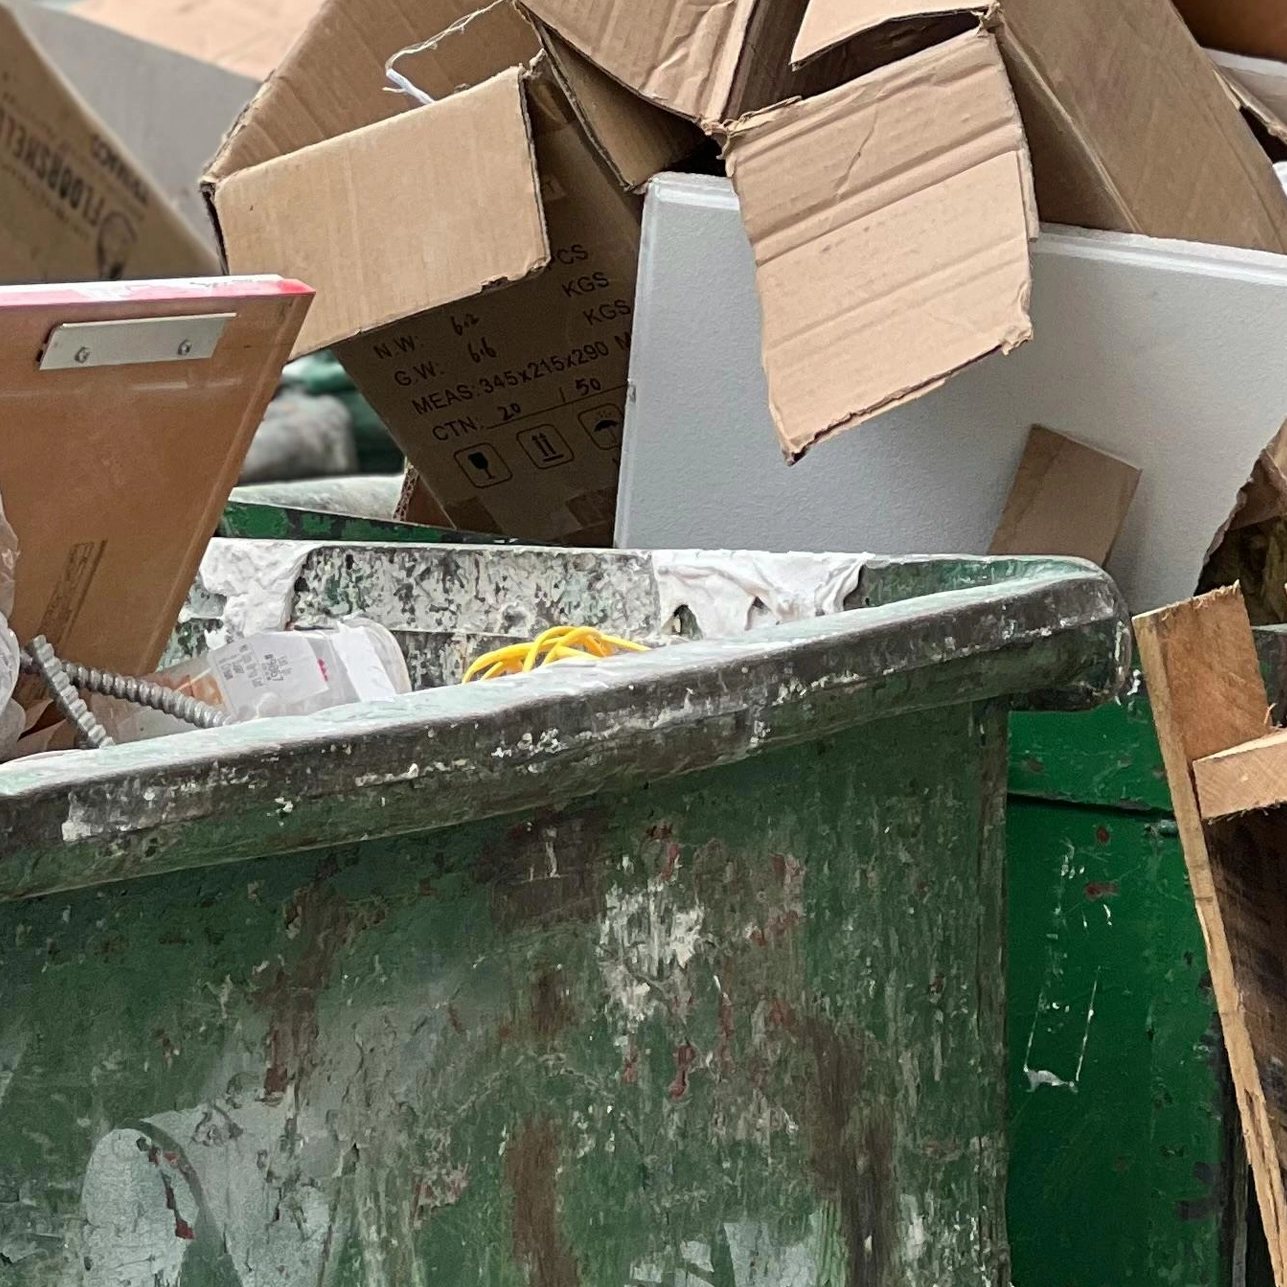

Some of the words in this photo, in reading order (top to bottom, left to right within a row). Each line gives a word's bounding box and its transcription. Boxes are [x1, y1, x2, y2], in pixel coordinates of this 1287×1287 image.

[0, 110, 103, 228] FLOORSHEL
[550, 244, 588, 265] CS
[562, 271, 609, 298] KGS
[583, 299, 631, 326] KGS
